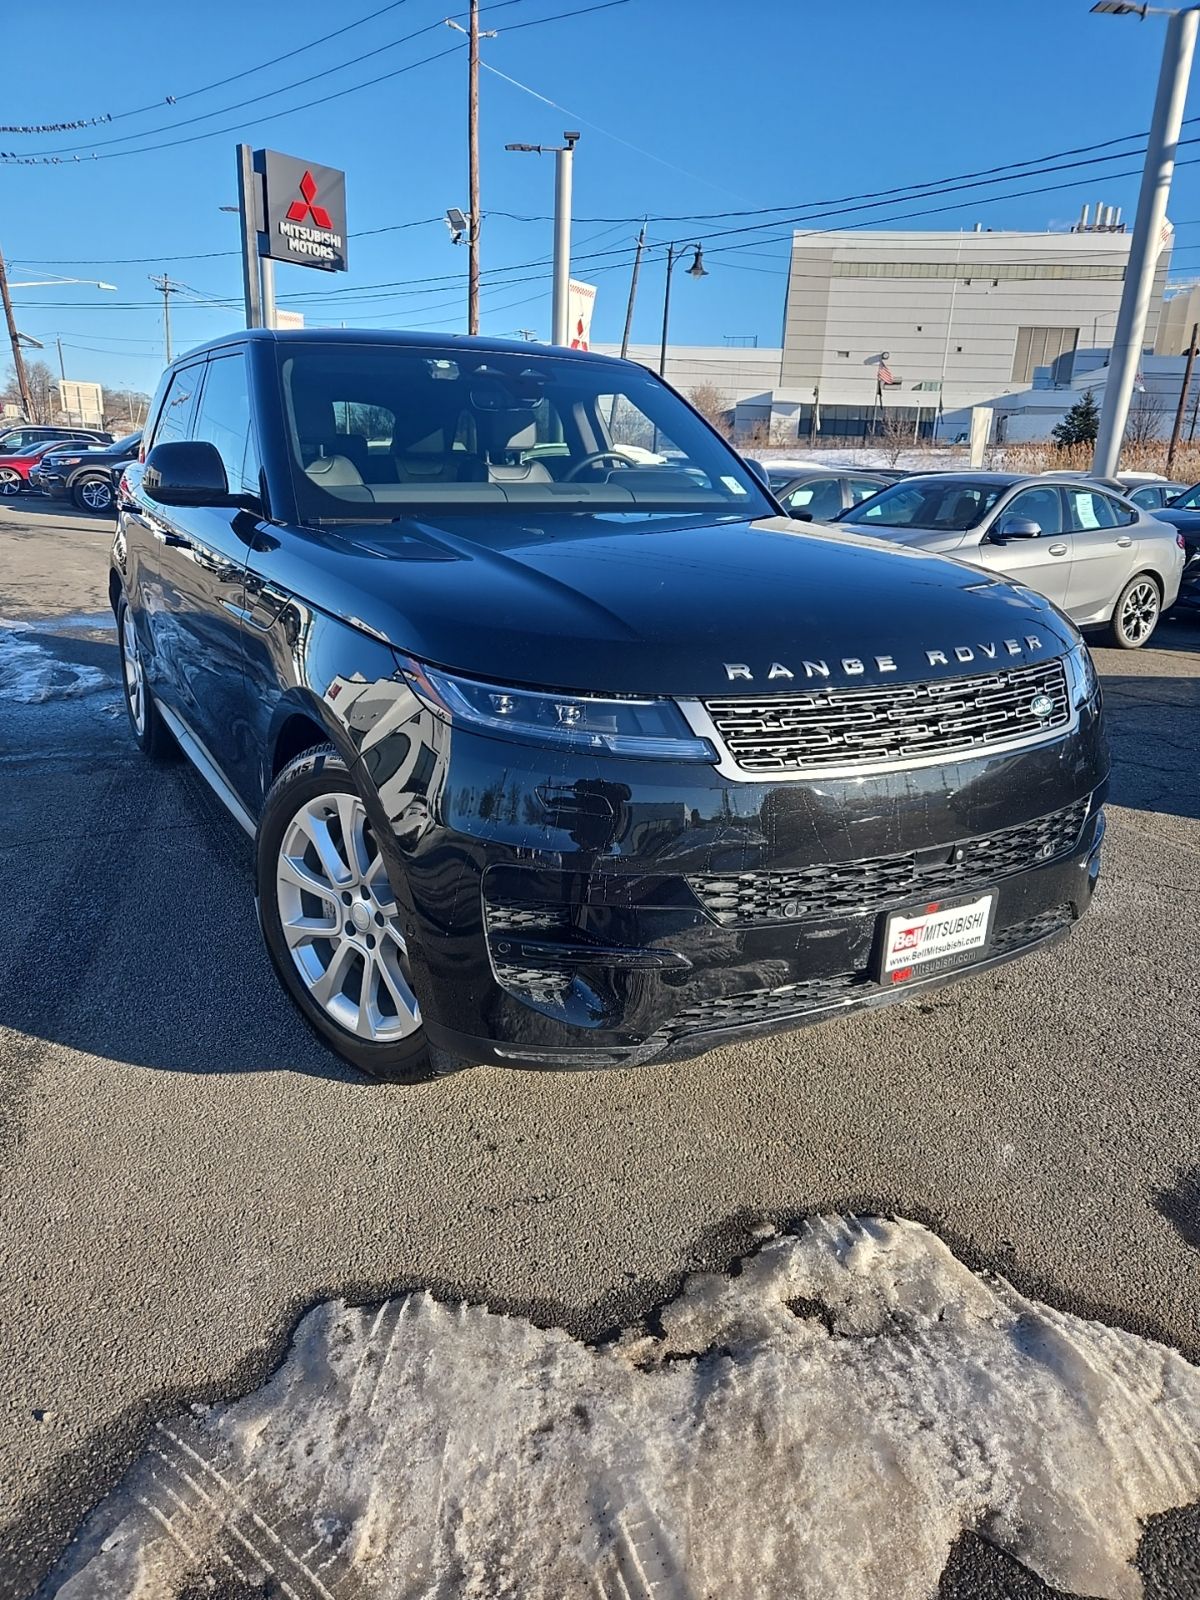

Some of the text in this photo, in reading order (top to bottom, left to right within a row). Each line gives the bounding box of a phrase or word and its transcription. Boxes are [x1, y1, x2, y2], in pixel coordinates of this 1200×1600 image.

[279, 221, 342, 249] MITSUBISHI
[288, 238, 335, 260] MOTORS
[723, 634, 1043, 680] RANGE ROVER
[893, 911, 985, 953] Bell MITSUBISHI
[889, 936, 982, 966] www.BellMitsubishi.com
